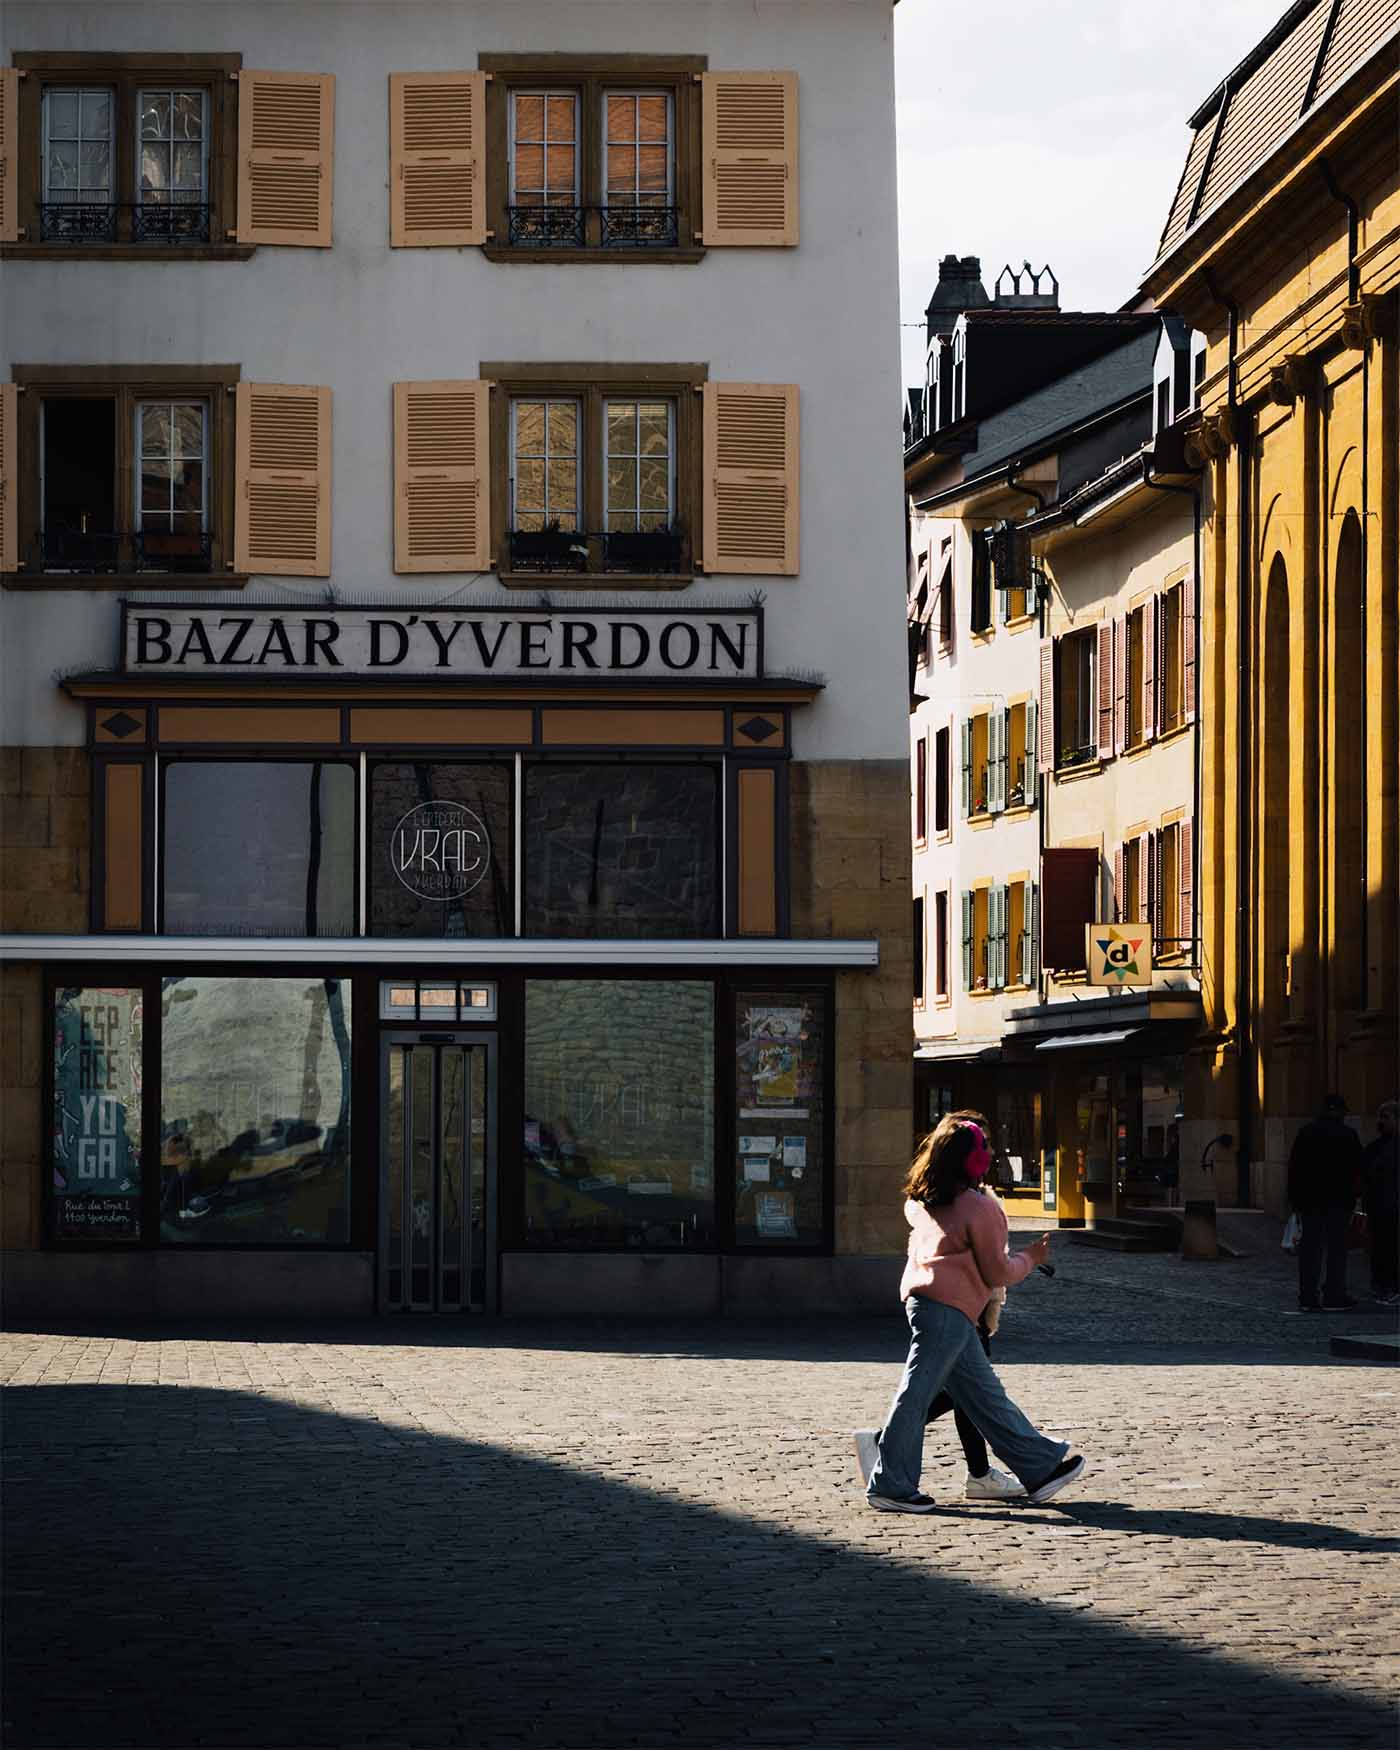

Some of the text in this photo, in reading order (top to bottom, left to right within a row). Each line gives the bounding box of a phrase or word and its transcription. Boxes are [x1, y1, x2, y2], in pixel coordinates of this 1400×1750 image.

[133, 615, 751, 671] BAZAR D'YVERDON
[400, 829, 481, 872] VRAC
[1109, 943, 1129, 963] d
[79, 1005, 120, 1047] ESP
[79, 1049, 119, 1090] ACE
[79, 1094, 118, 1136] YO
[77, 1137, 118, 1180] GA
[64, 1199, 85, 1211] Rue
[87, 1199, 102, 1210] du
